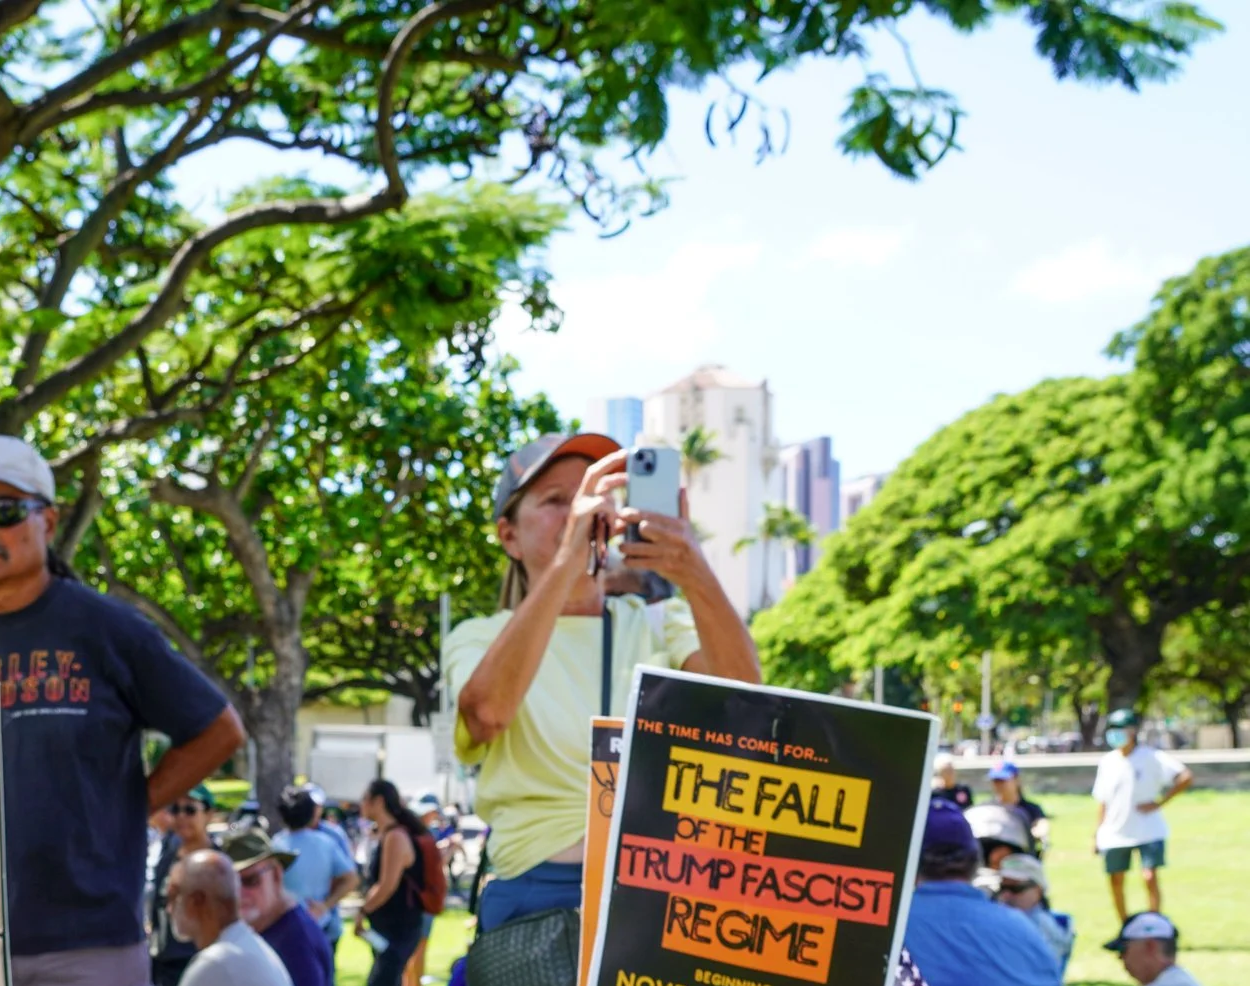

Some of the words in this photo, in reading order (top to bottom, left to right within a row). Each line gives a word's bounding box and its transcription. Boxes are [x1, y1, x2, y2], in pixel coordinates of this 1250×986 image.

[637, 718, 664, 734] THE
[668, 724, 701, 741] TIME
[705, 731, 733, 746] HAS
[738, 736, 778, 755] COME
[783, 744, 830, 763] FOR...
[668, 760, 749, 813] THE
[753, 776, 857, 833] FALL
[676, 817, 707, 840] OF
[715, 823, 764, 856] THE
[621, 844, 735, 890] TRUMP
[740, 864, 892, 914] FASCIST
[667, 896, 825, 967] REGIME
